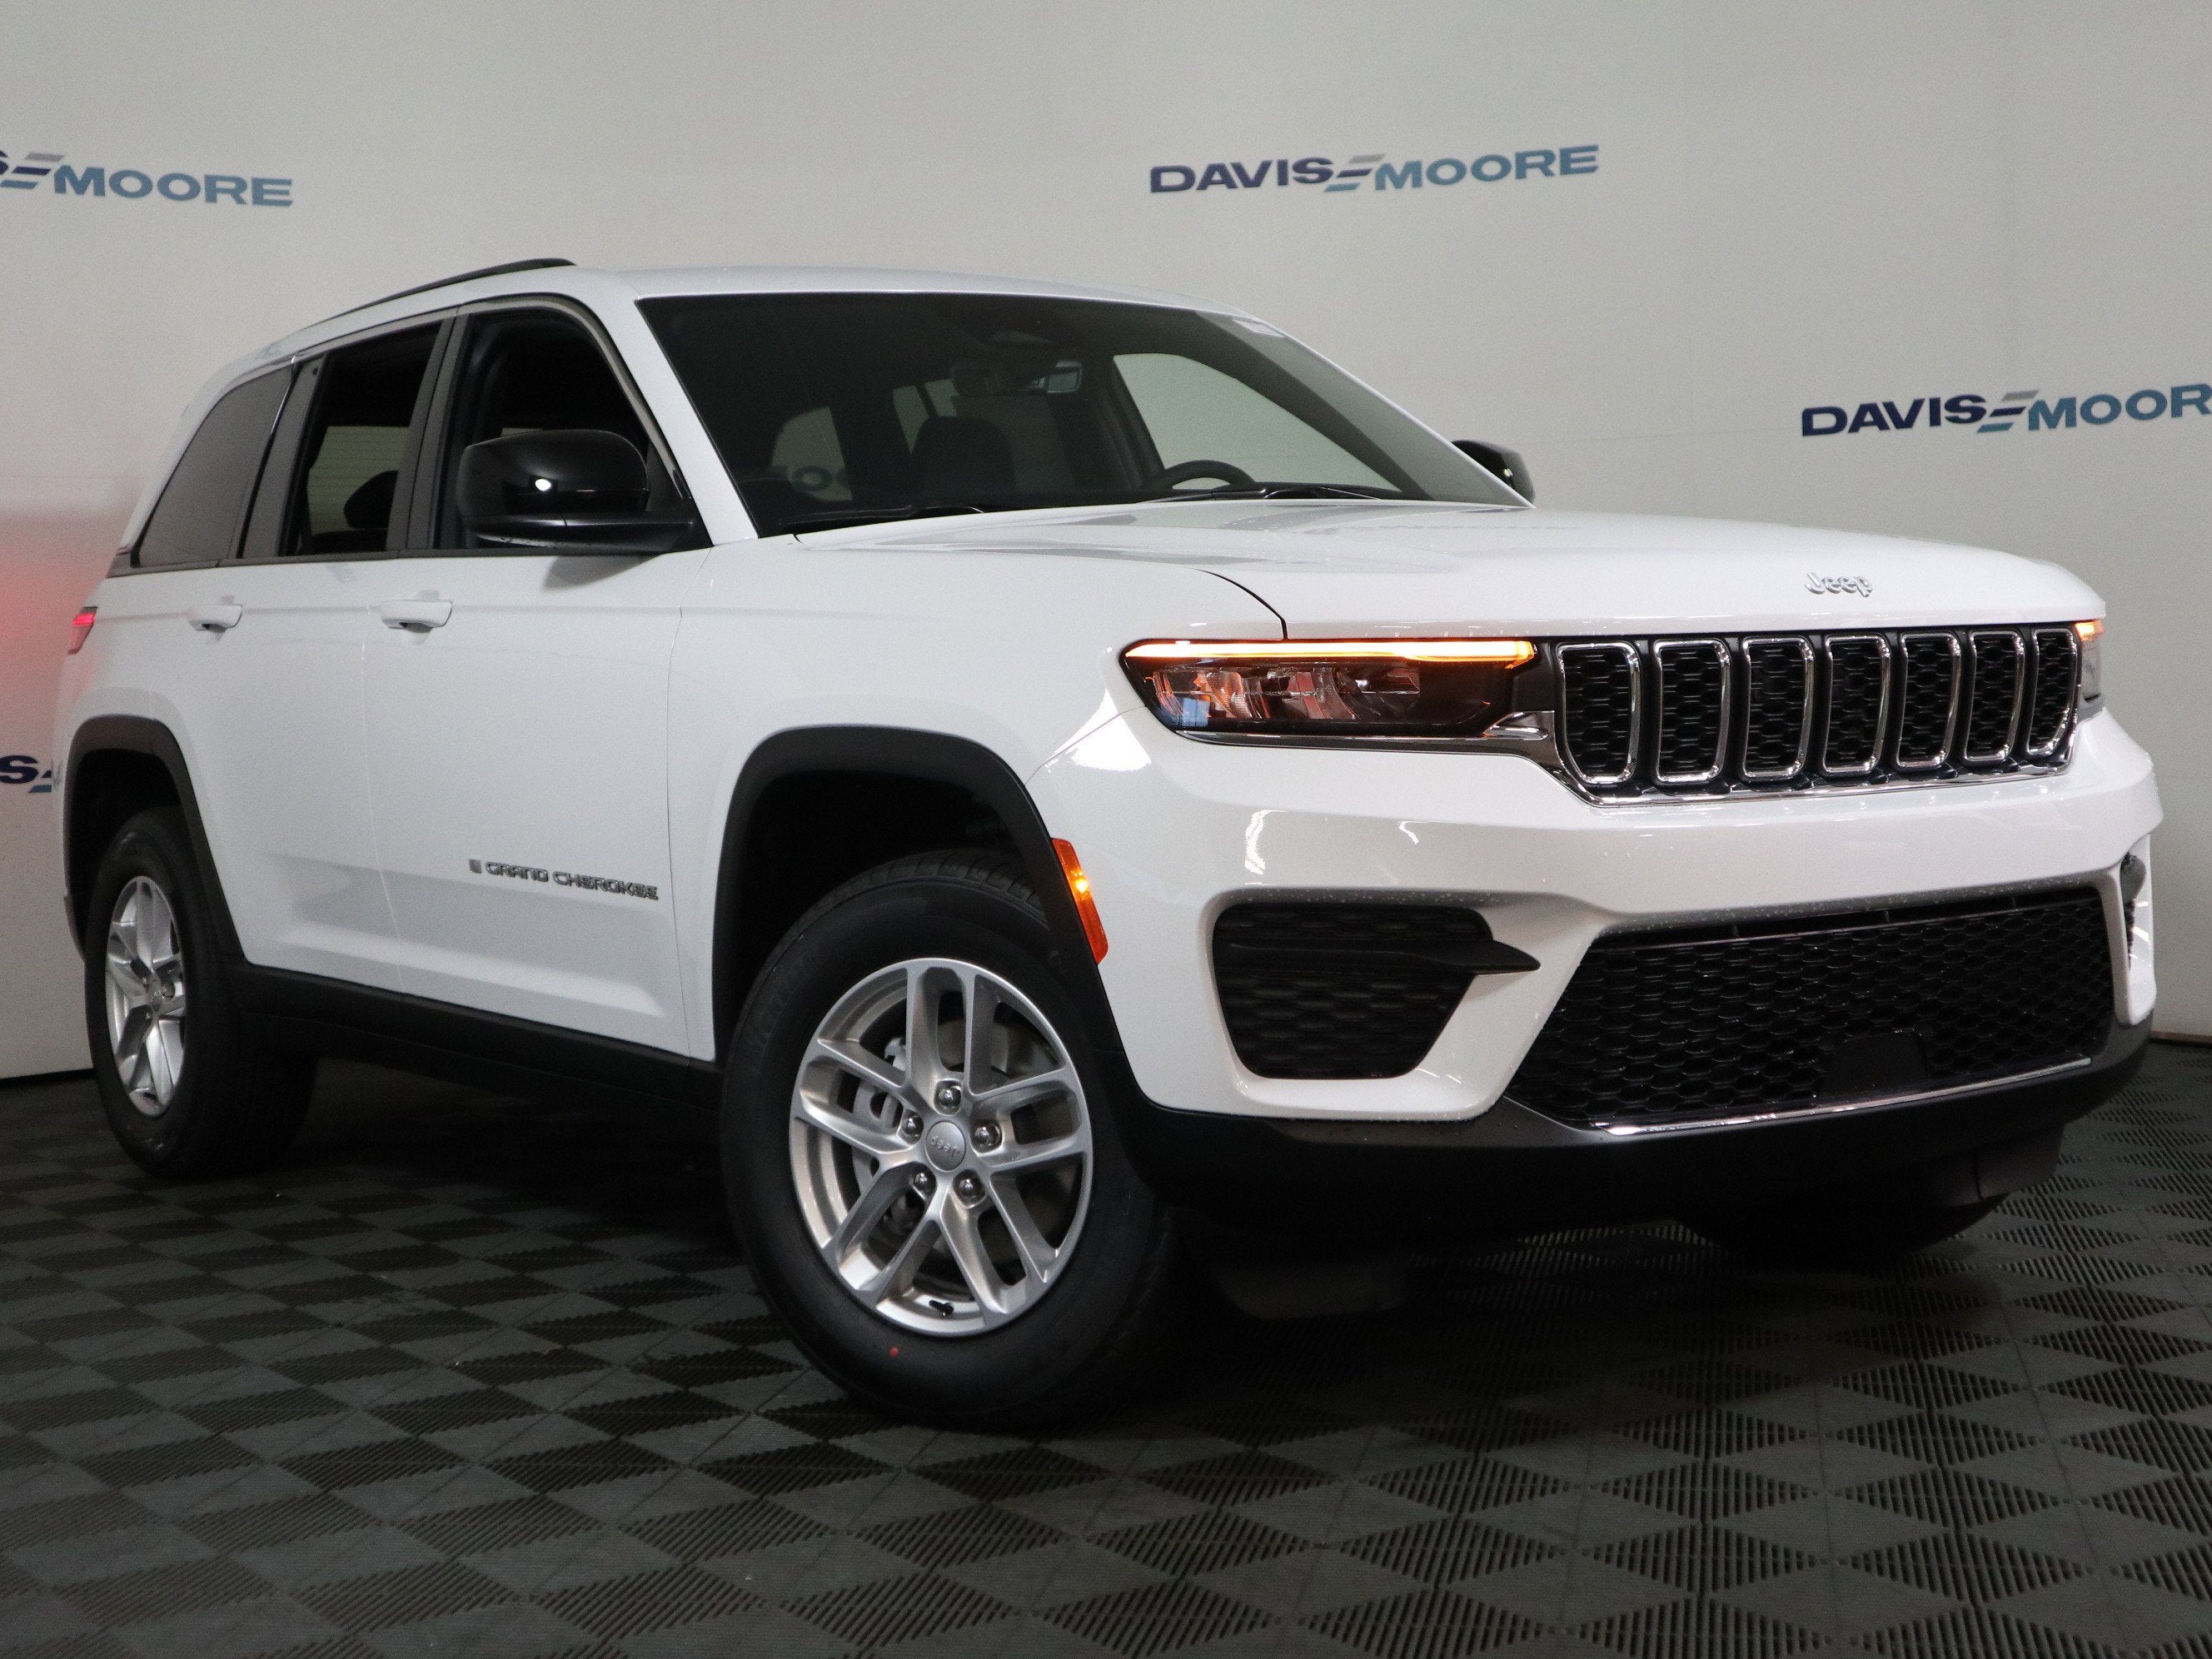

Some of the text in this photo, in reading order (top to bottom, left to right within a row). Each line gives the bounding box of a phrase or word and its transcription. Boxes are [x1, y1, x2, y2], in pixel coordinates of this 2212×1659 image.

[53, 164, 293, 207] MOORE
[1149, 144, 1599, 193] DAVIS MOORE
[1801, 396, 1988, 438] DAVIS
[1805, 571, 1874, 598] Jeep
[485, 861, 660, 901] GRAND CHEROKEE
